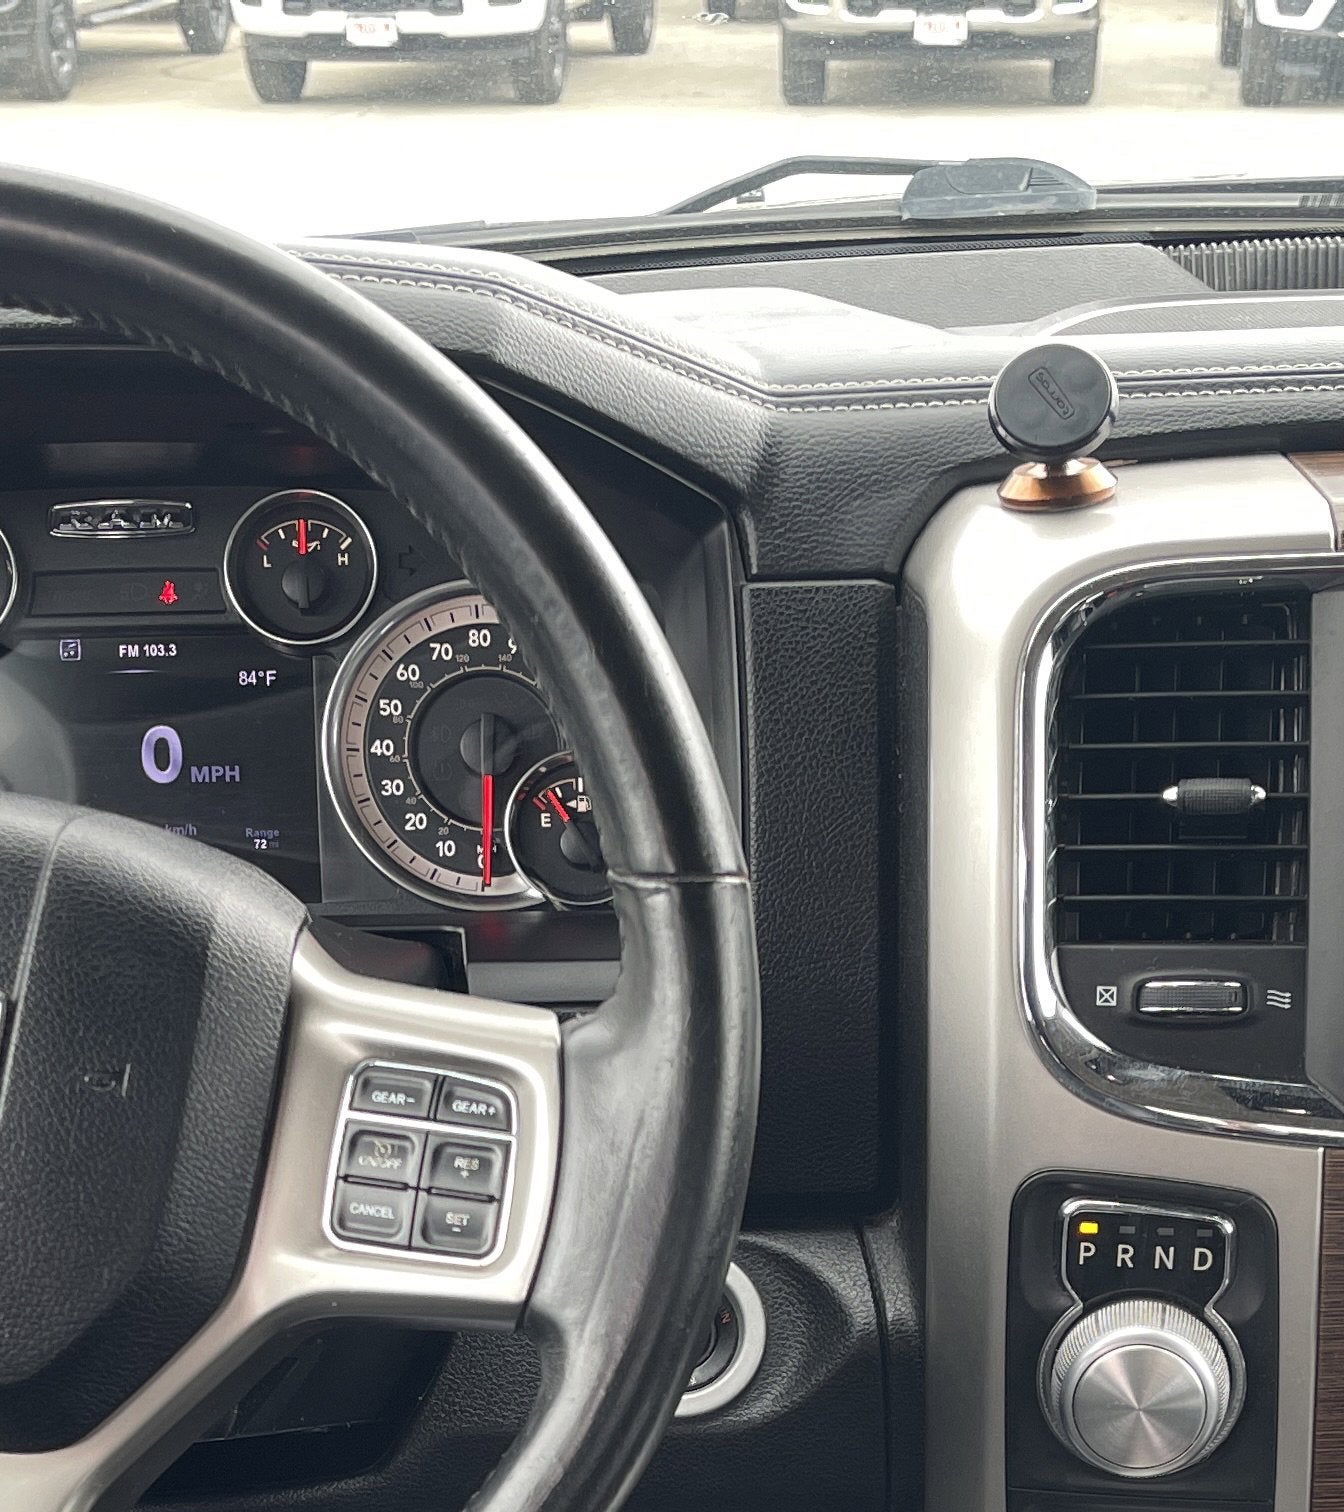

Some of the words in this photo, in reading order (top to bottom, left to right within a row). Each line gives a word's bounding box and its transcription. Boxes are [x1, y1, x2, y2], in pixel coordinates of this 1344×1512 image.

[263, 554, 272, 568] L
[337, 552, 349, 566] H
[468, 628, 491, 648] 80
[118, 644, 140, 658] FM
[142, 643, 177, 657] 103.3
[429, 642, 453, 661] 70
[238, 669, 277, 687] 84°F
[396, 663, 420, 682] 60
[379, 698, 402, 717] 50
[141, 725, 183, 784] 0
[190, 765, 241, 783] MPH
[370, 738, 394, 757] 40
[380, 778, 404, 796] 30
[404, 812, 428, 831] 20
[540, 812, 552, 828] E
[245, 827, 280, 839] Range
[253, 838, 268, 850] 72
[435, 839, 456, 858] 10
[454, 1156, 480, 1170] RES
[350, 1202, 395, 1219] CANCEL
[445, 1211, 470, 1226] SET
[1078, 1241, 1096, 1265] P
[1116, 1243, 1134, 1268] R
[1154, 1245, 1175, 1270] N
[1193, 1247, 1213, 1271] D
